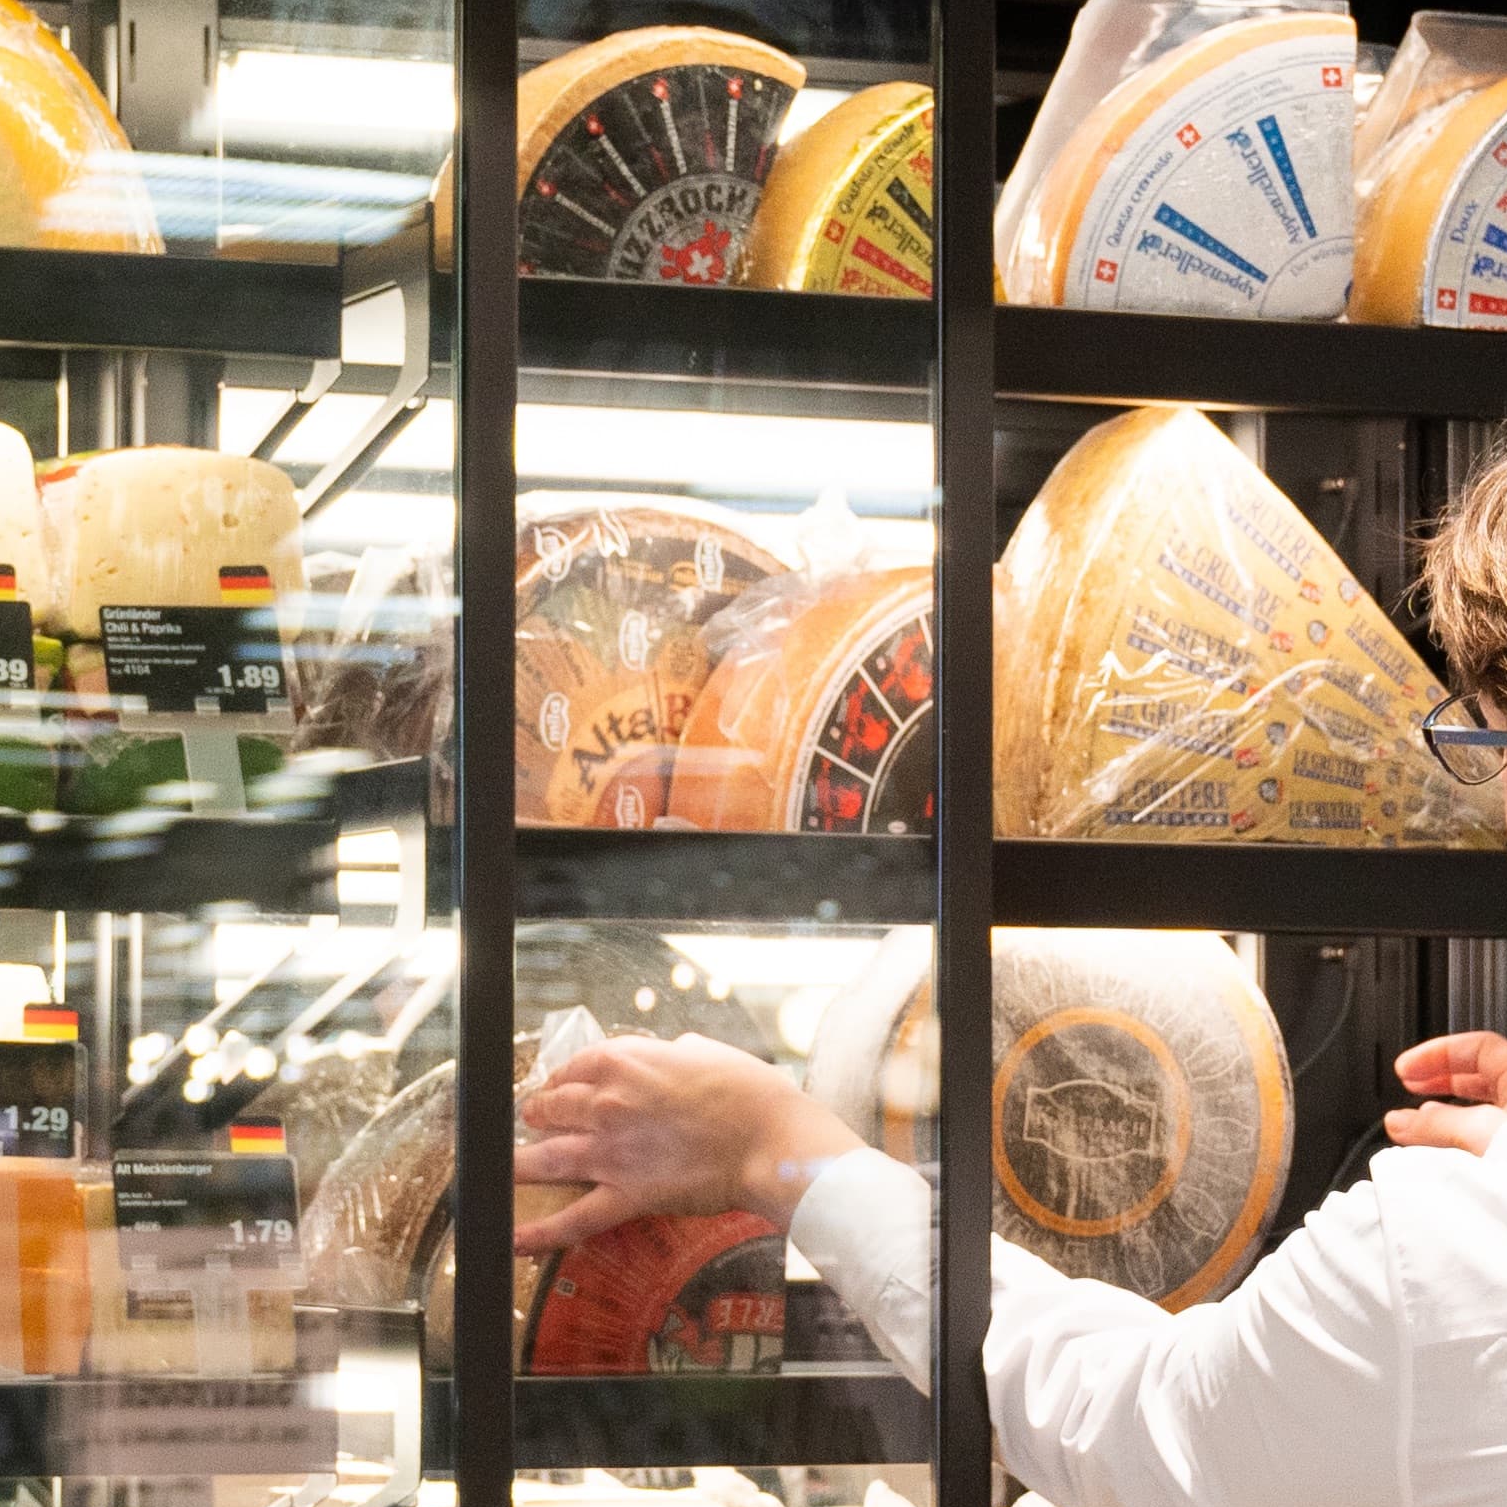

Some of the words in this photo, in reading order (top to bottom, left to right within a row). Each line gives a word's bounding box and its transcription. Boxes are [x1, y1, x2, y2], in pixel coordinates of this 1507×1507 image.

[1239, 144, 1305, 246] Appenzeller
[1449, 198, 1478, 244] Doux
[1157, 243, 1261, 301] Appenzeller
[102, 608, 163, 622] Grünländer
[104, 621, 130, 635] Chili
[130, 623, 141, 635] &
[141, 622, 183, 638] Paprika
[217, 663, 281, 689] 1.89
[569, 704, 657, 793] Alta
[2, 1104, 70, 1133] 1.29
[114, 1163, 131, 1176] Alt
[132, 1163, 214, 1178] Mecklenburger
[228, 1218, 295, 1245] 1.79
